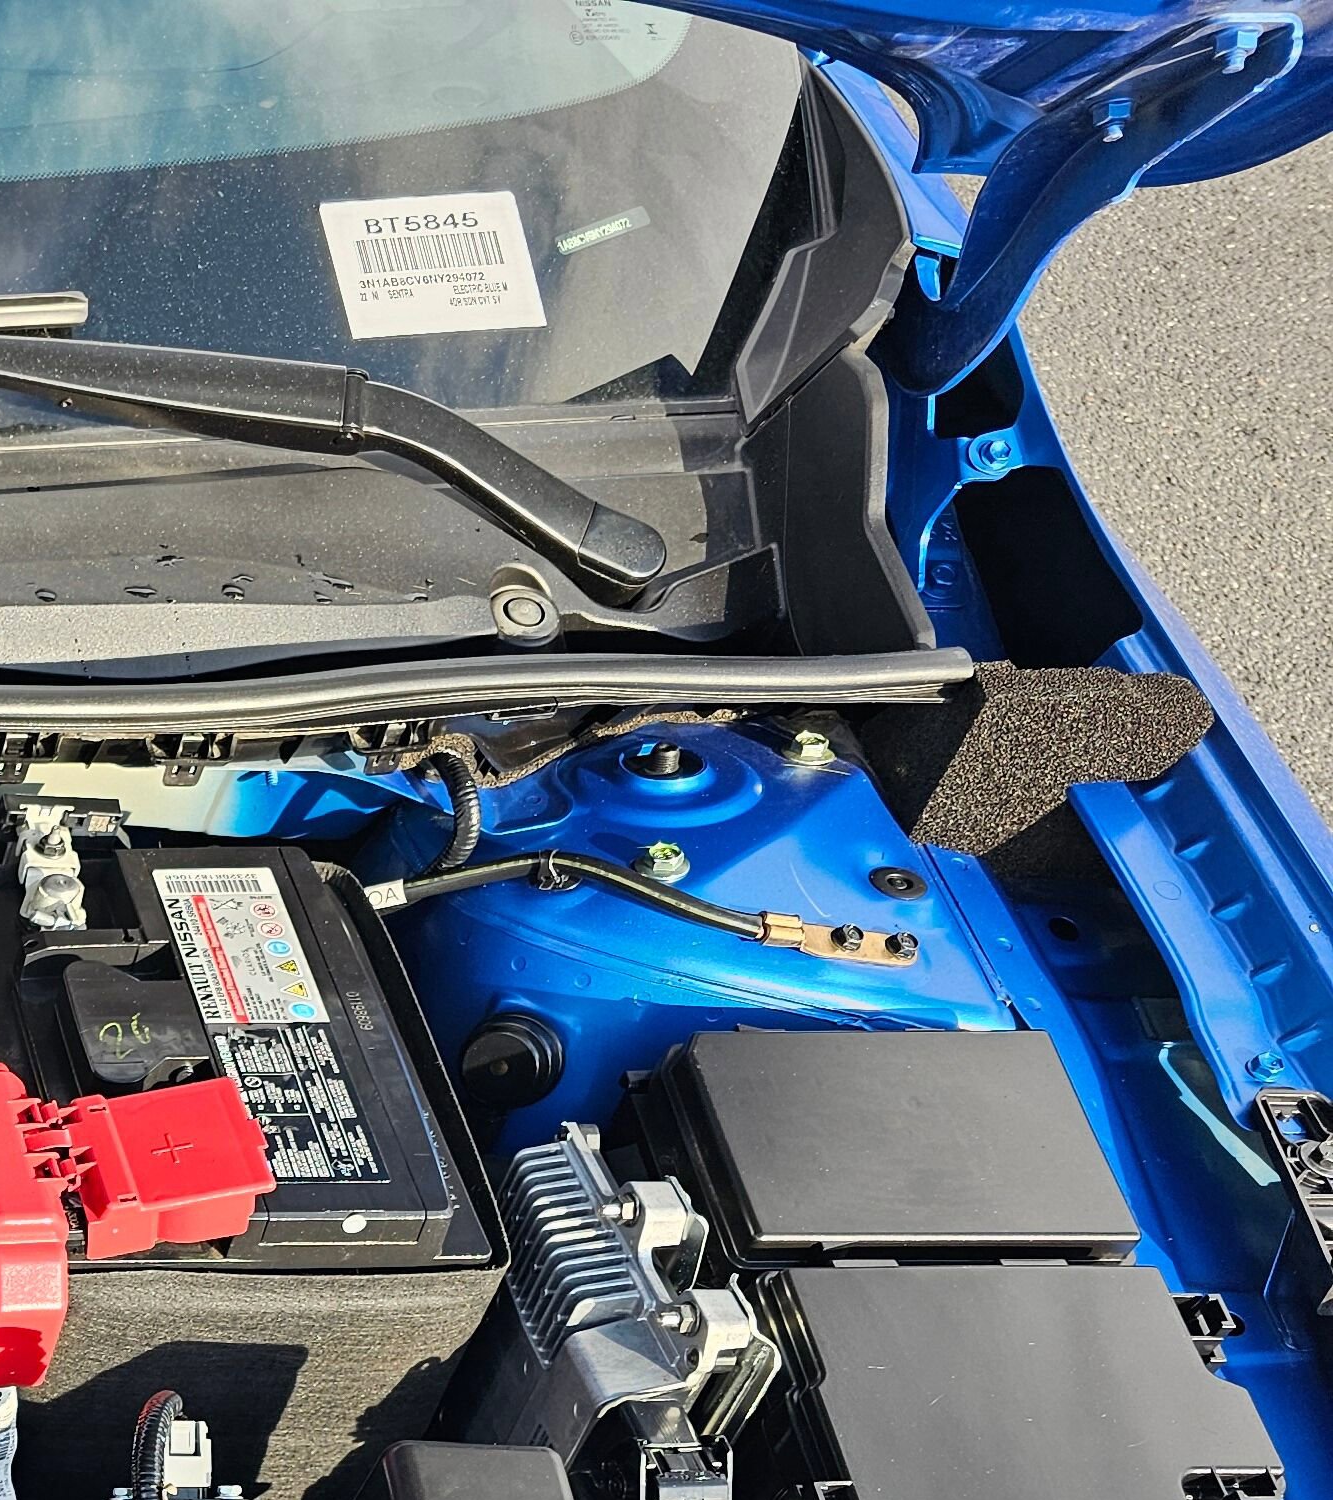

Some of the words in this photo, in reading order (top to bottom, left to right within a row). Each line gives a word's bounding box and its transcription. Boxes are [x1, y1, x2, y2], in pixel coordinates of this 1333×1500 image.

[365, 211, 479, 233] BT5845
[164, 897, 200, 959] NISSAN
[186, 962, 222, 1020] RENAULT
